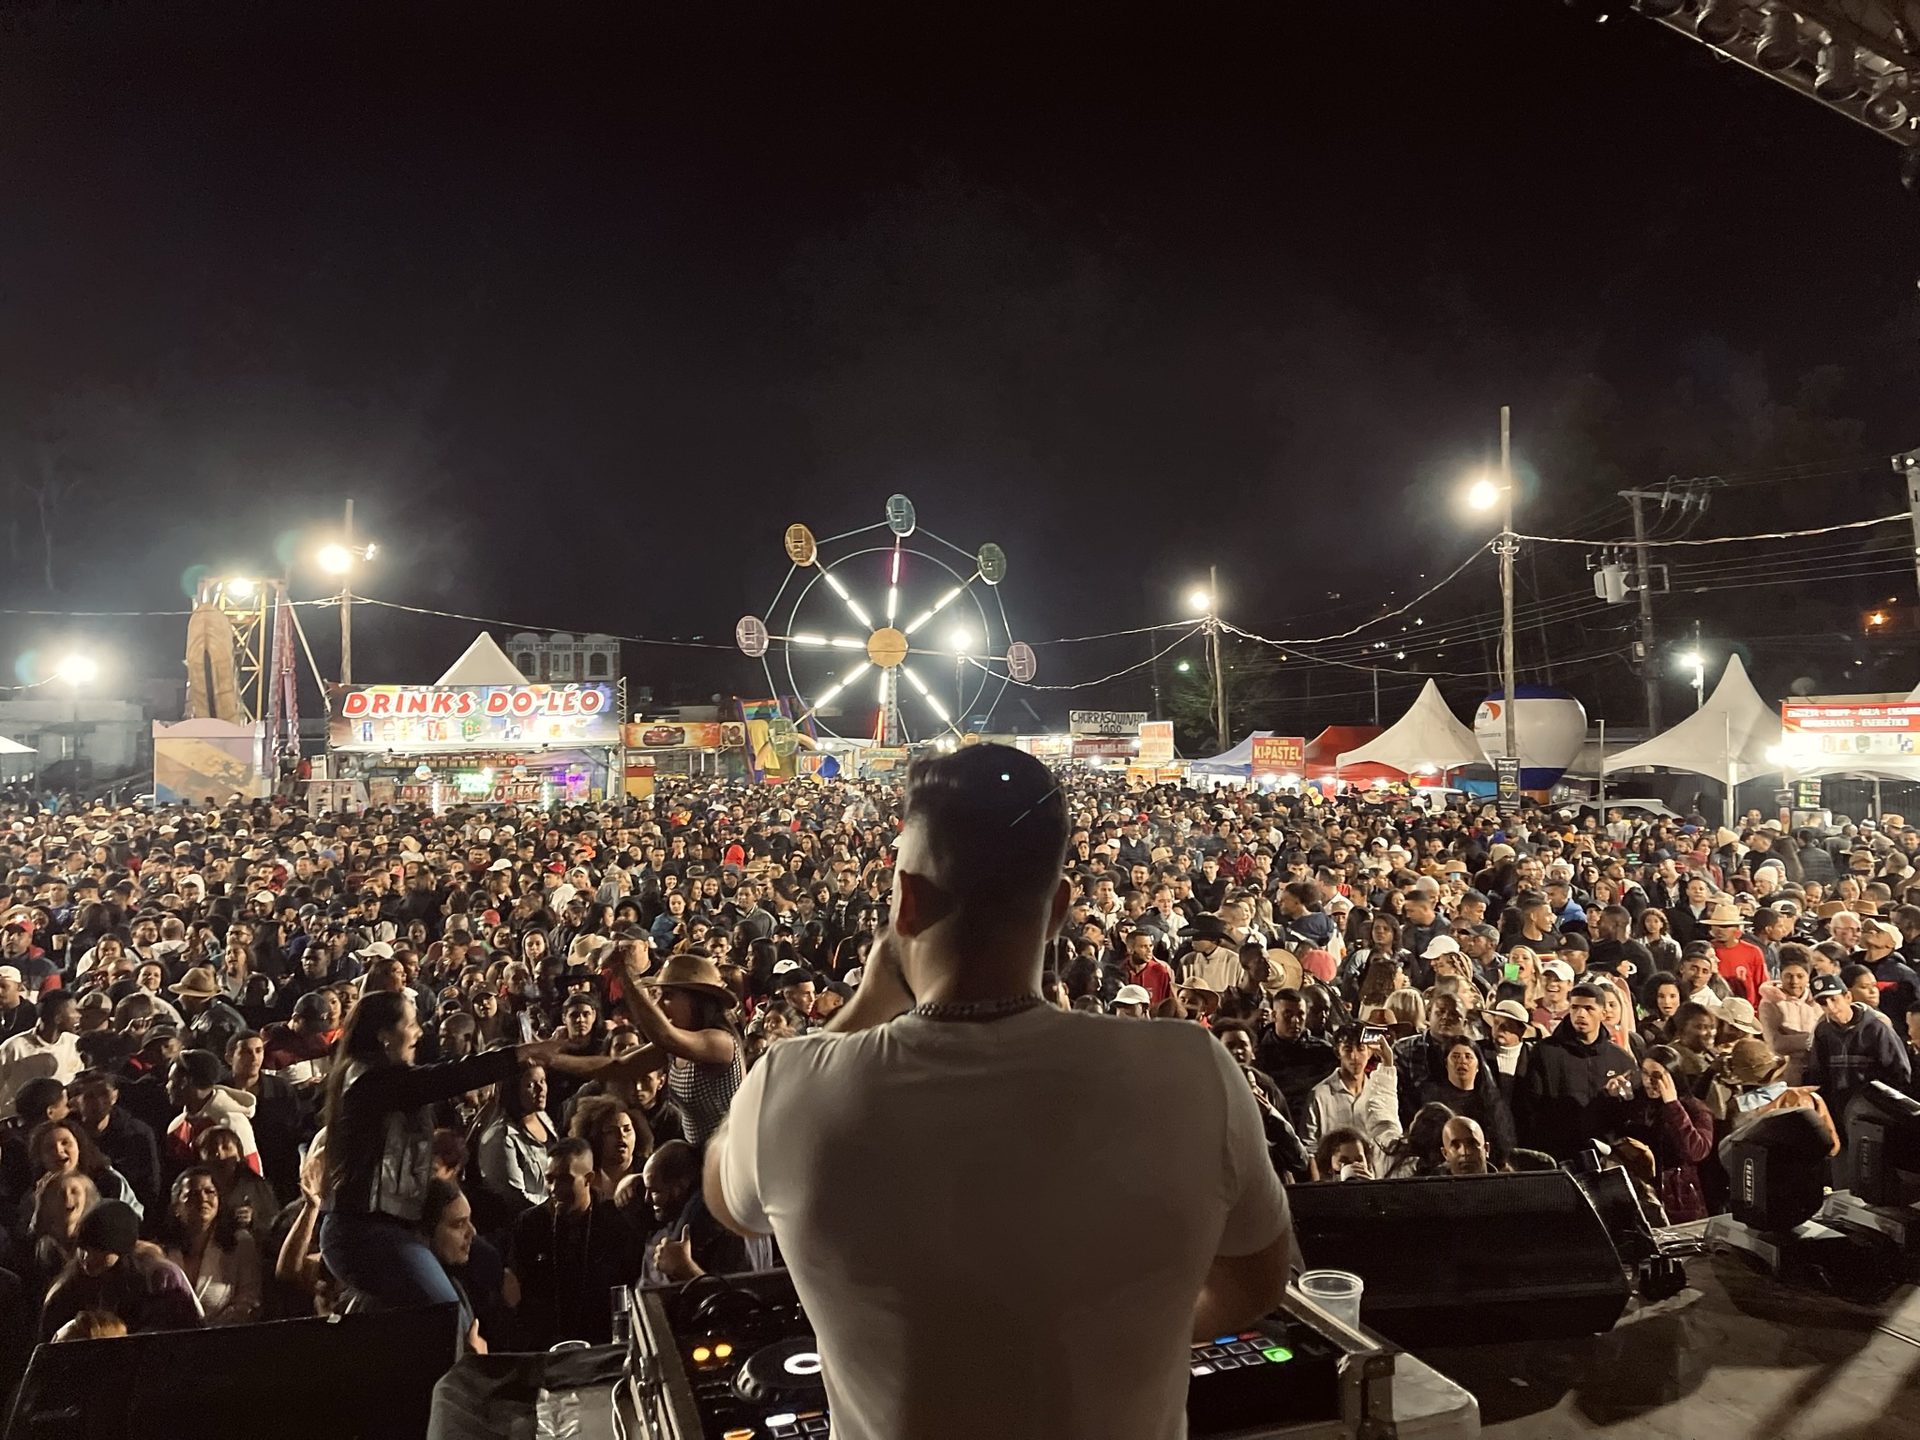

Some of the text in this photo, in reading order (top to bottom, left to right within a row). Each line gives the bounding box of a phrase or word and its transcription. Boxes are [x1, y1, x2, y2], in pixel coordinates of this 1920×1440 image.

[343, 684, 603, 717] DRINKS DO LÉO
[1071, 711, 1146, 727] CHURRASQUINHO
[1254, 744, 1302, 761] KI-PASTEL
